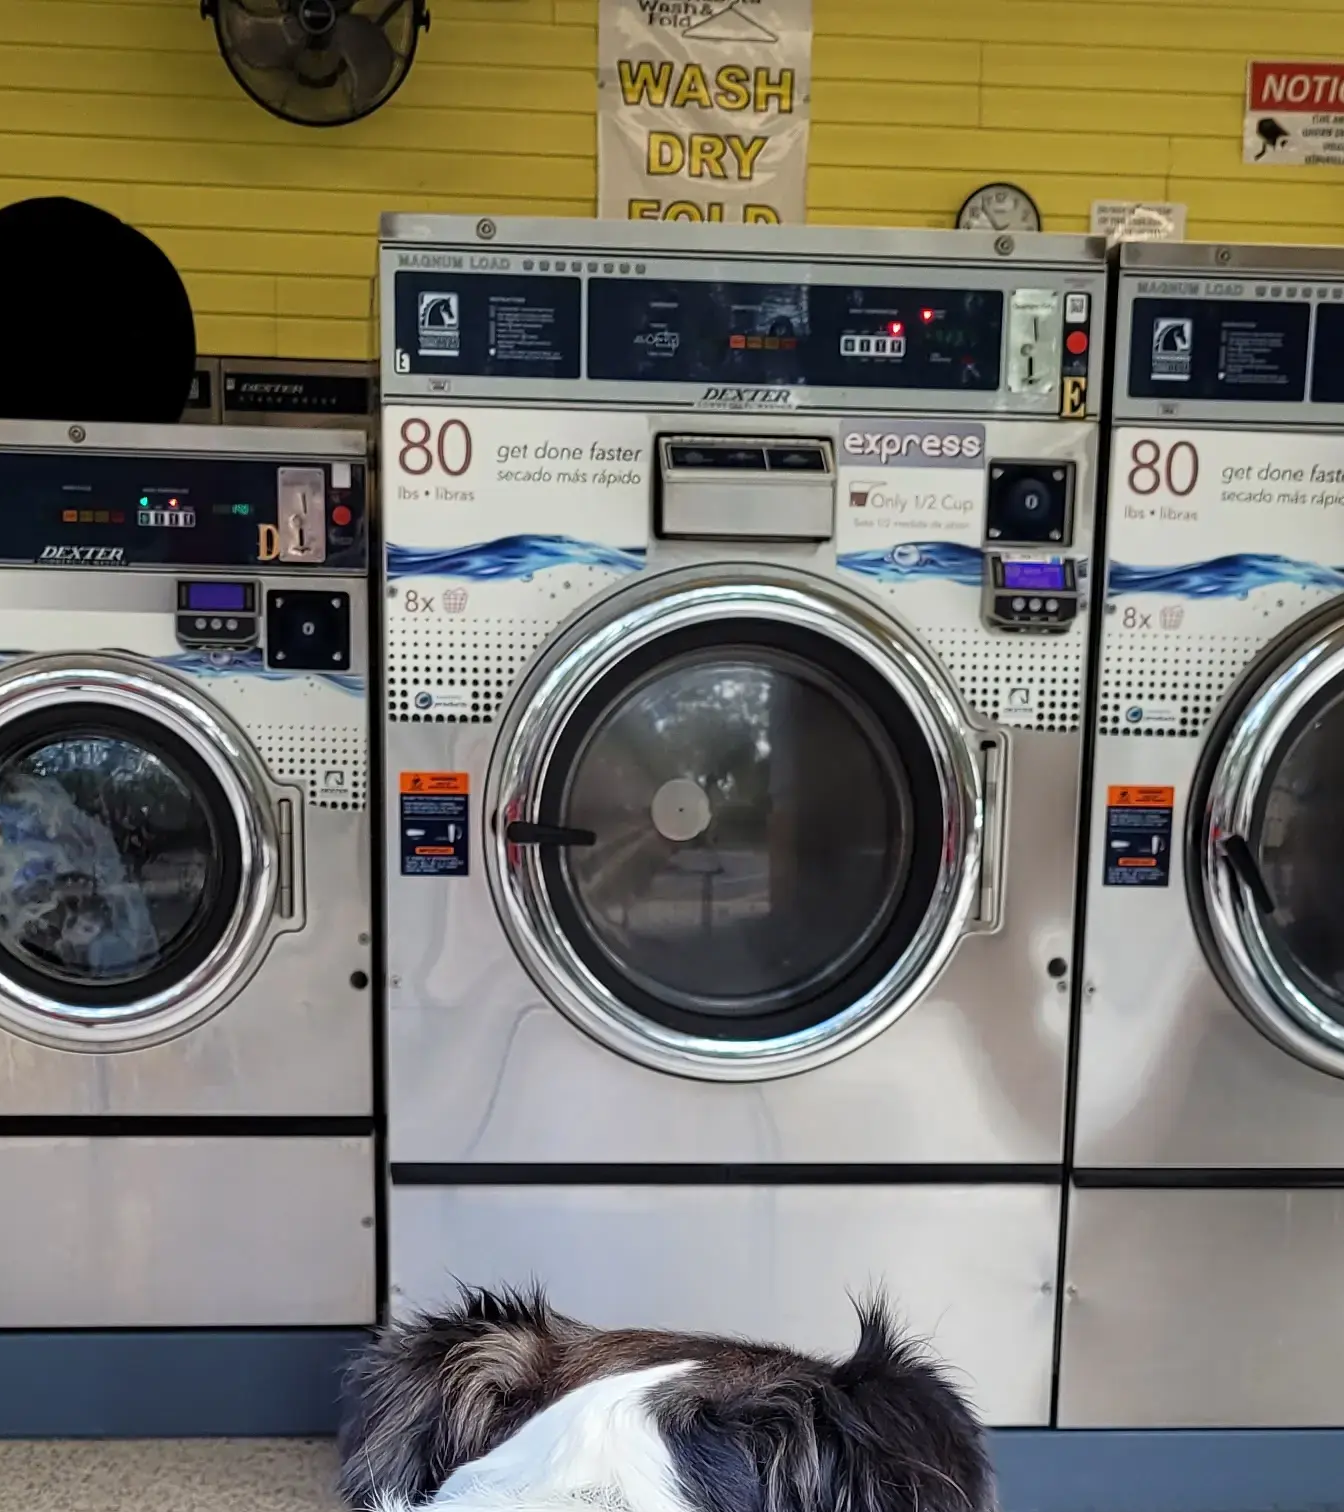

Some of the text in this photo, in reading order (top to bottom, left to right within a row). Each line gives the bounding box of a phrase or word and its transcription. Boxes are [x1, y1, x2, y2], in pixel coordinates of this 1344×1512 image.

[617, 59, 794, 114] WASH
[647, 130, 768, 181] DRY
[398, 254, 510, 271] MAGNUM LOAD
[1206, 284, 1244, 297] LOAD
[701, 386, 791, 403] DEXTER
[1061, 376, 1086, 417] E
[398, 418, 472, 476] 80
[496, 441, 643, 463] get done faster
[843, 432, 982, 463] express
[496, 467, 552, 483] secado
[592, 470, 641, 487] rápido
[1128, 439, 1199, 497] 80
[1221, 465, 1251, 483] get
[1257, 462, 1303, 482] done
[398, 486, 475, 502] lbs libras
[870, 493, 973, 515] Only 1/2 Cup
[40, 545, 124, 560] DEXTER
[258, 524, 280, 560] D
[405, 590, 434, 613] 8x
[1122, 607, 1152, 630] 8x
